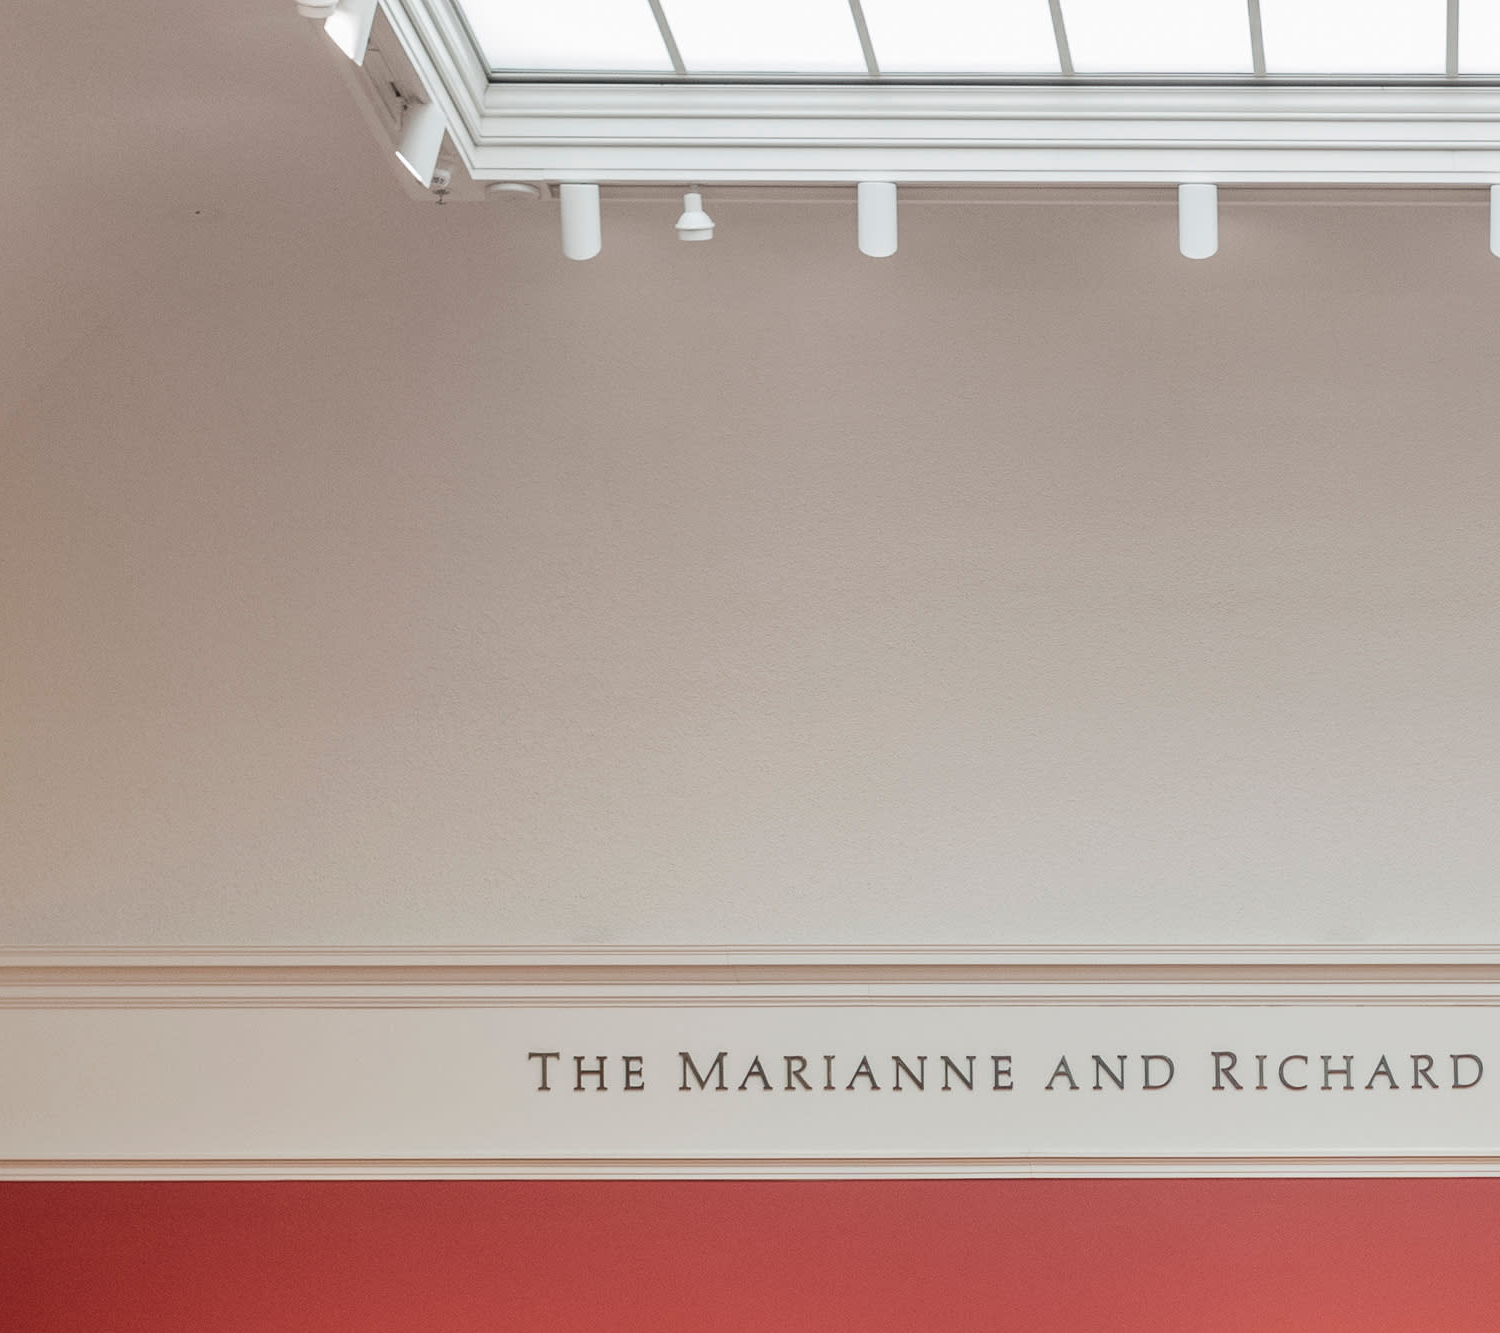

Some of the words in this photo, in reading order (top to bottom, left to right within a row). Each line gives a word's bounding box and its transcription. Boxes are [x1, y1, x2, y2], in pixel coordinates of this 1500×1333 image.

[527, 1050, 645, 1092] THE
[678, 1050, 1014, 1092] MARIANNE
[1044, 1053, 1175, 1091] AND
[1210, 1050, 1484, 1091] RICHARD
